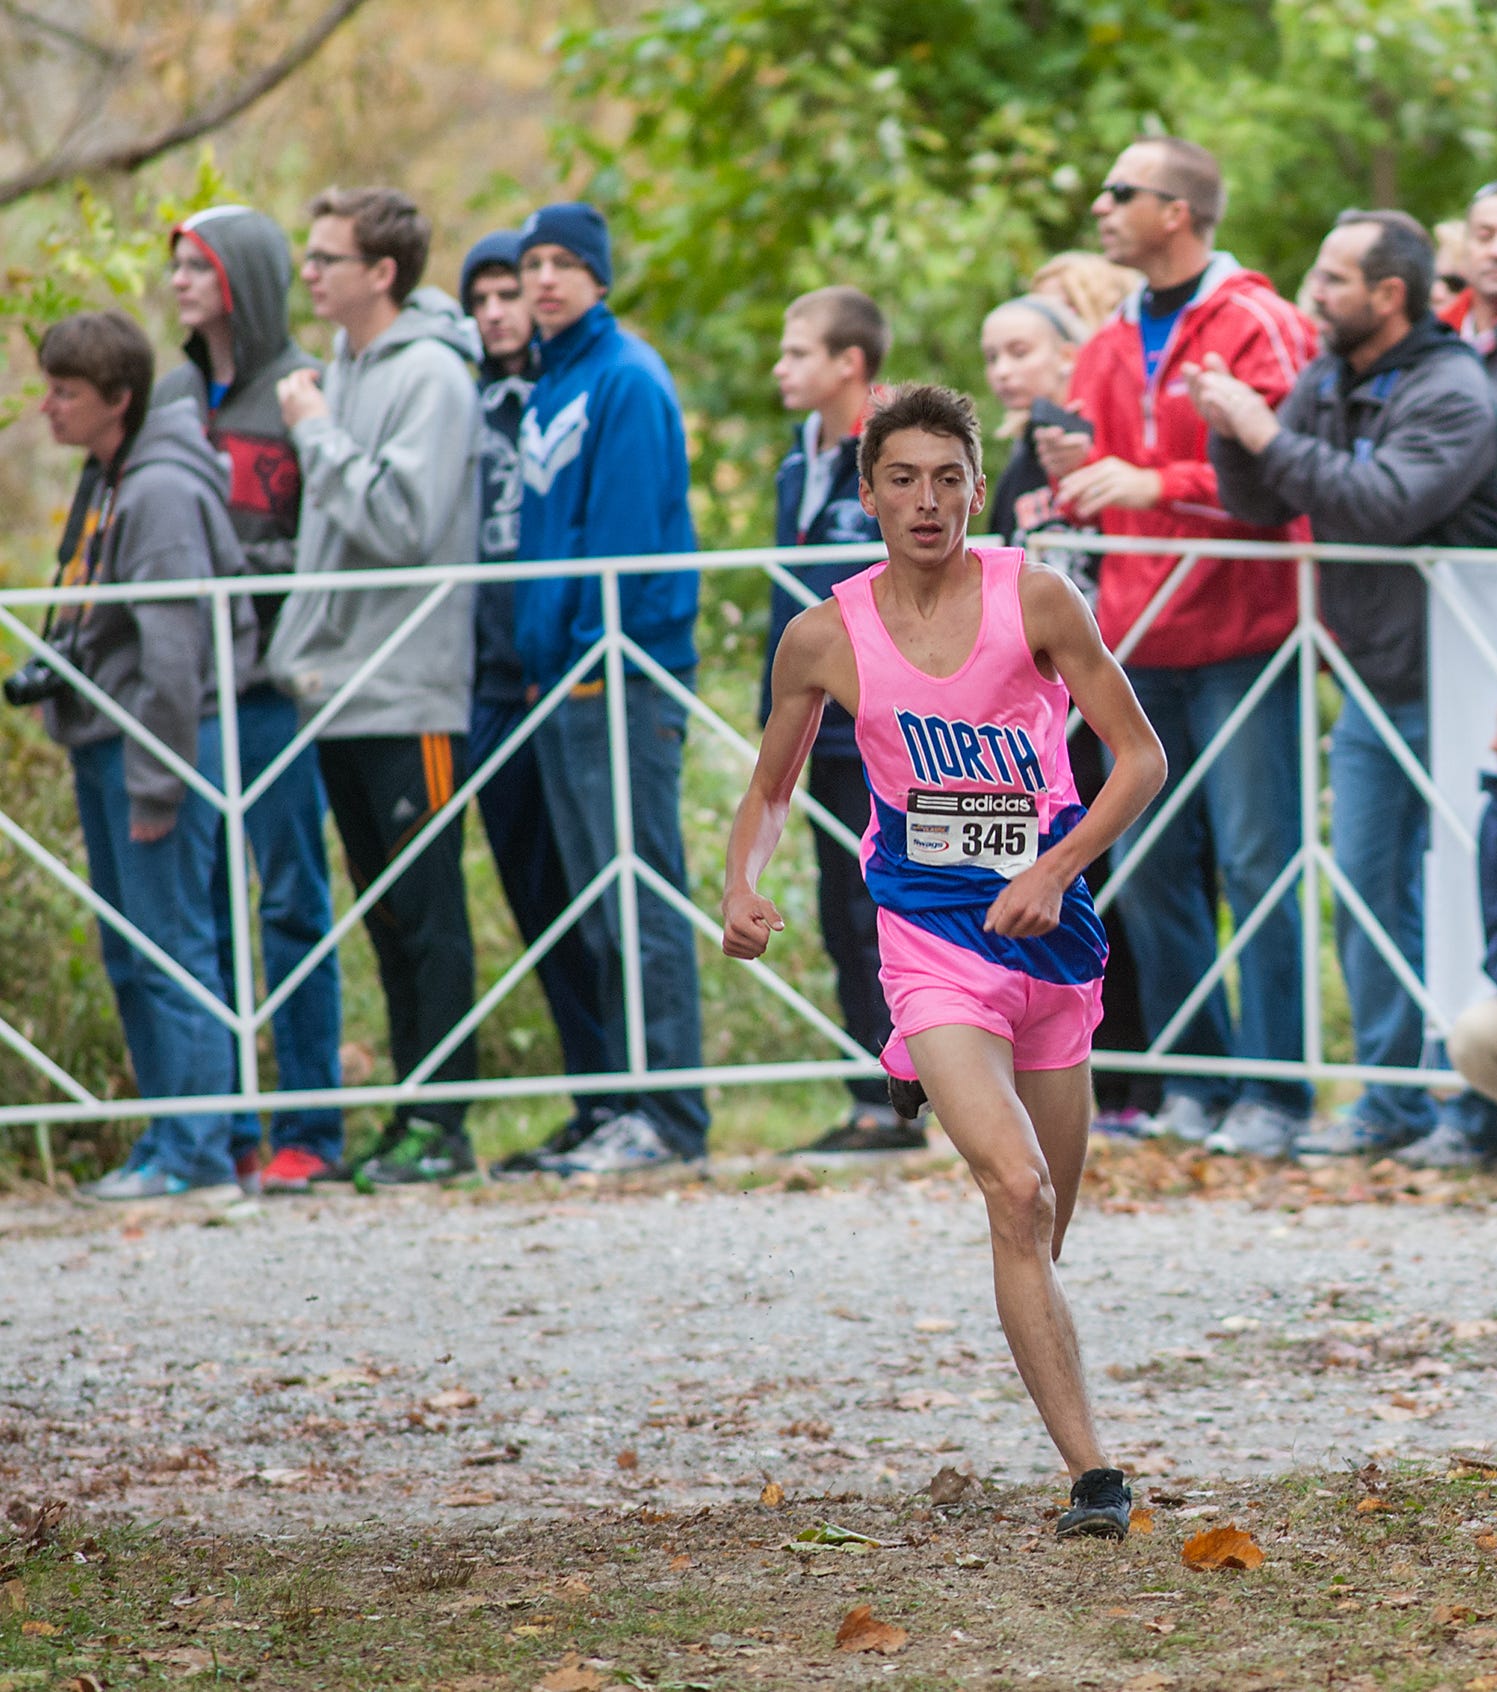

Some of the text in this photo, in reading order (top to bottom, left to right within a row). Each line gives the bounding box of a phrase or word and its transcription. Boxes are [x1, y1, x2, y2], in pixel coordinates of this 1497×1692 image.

[893, 706, 1049, 794] NORTH
[961, 795, 1031, 812] adidas
[961, 823, 1027, 856] 345
